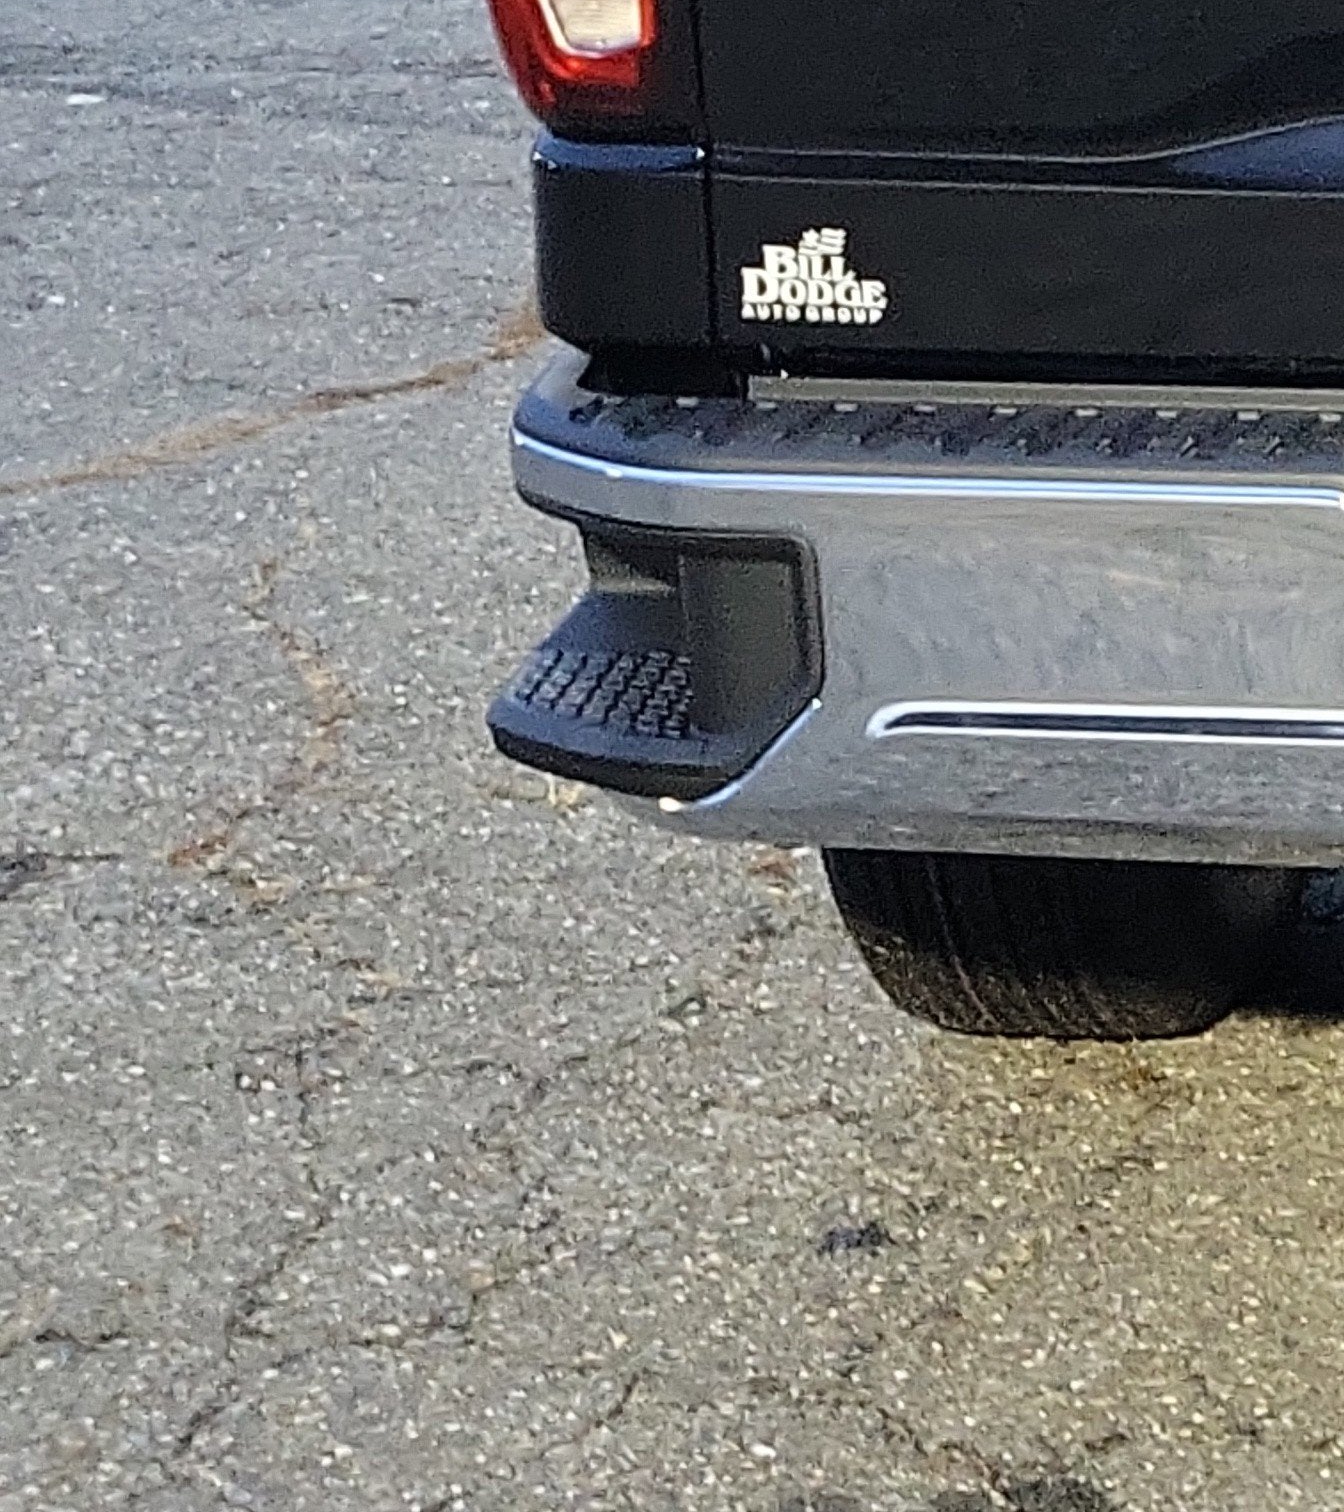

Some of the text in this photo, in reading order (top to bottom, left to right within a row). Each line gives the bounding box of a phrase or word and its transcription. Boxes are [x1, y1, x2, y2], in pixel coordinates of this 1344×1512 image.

[762, 243, 857, 281] BILL
[740, 266, 888, 309] DODGE
[740, 302, 884, 325] AUTO GROUP
